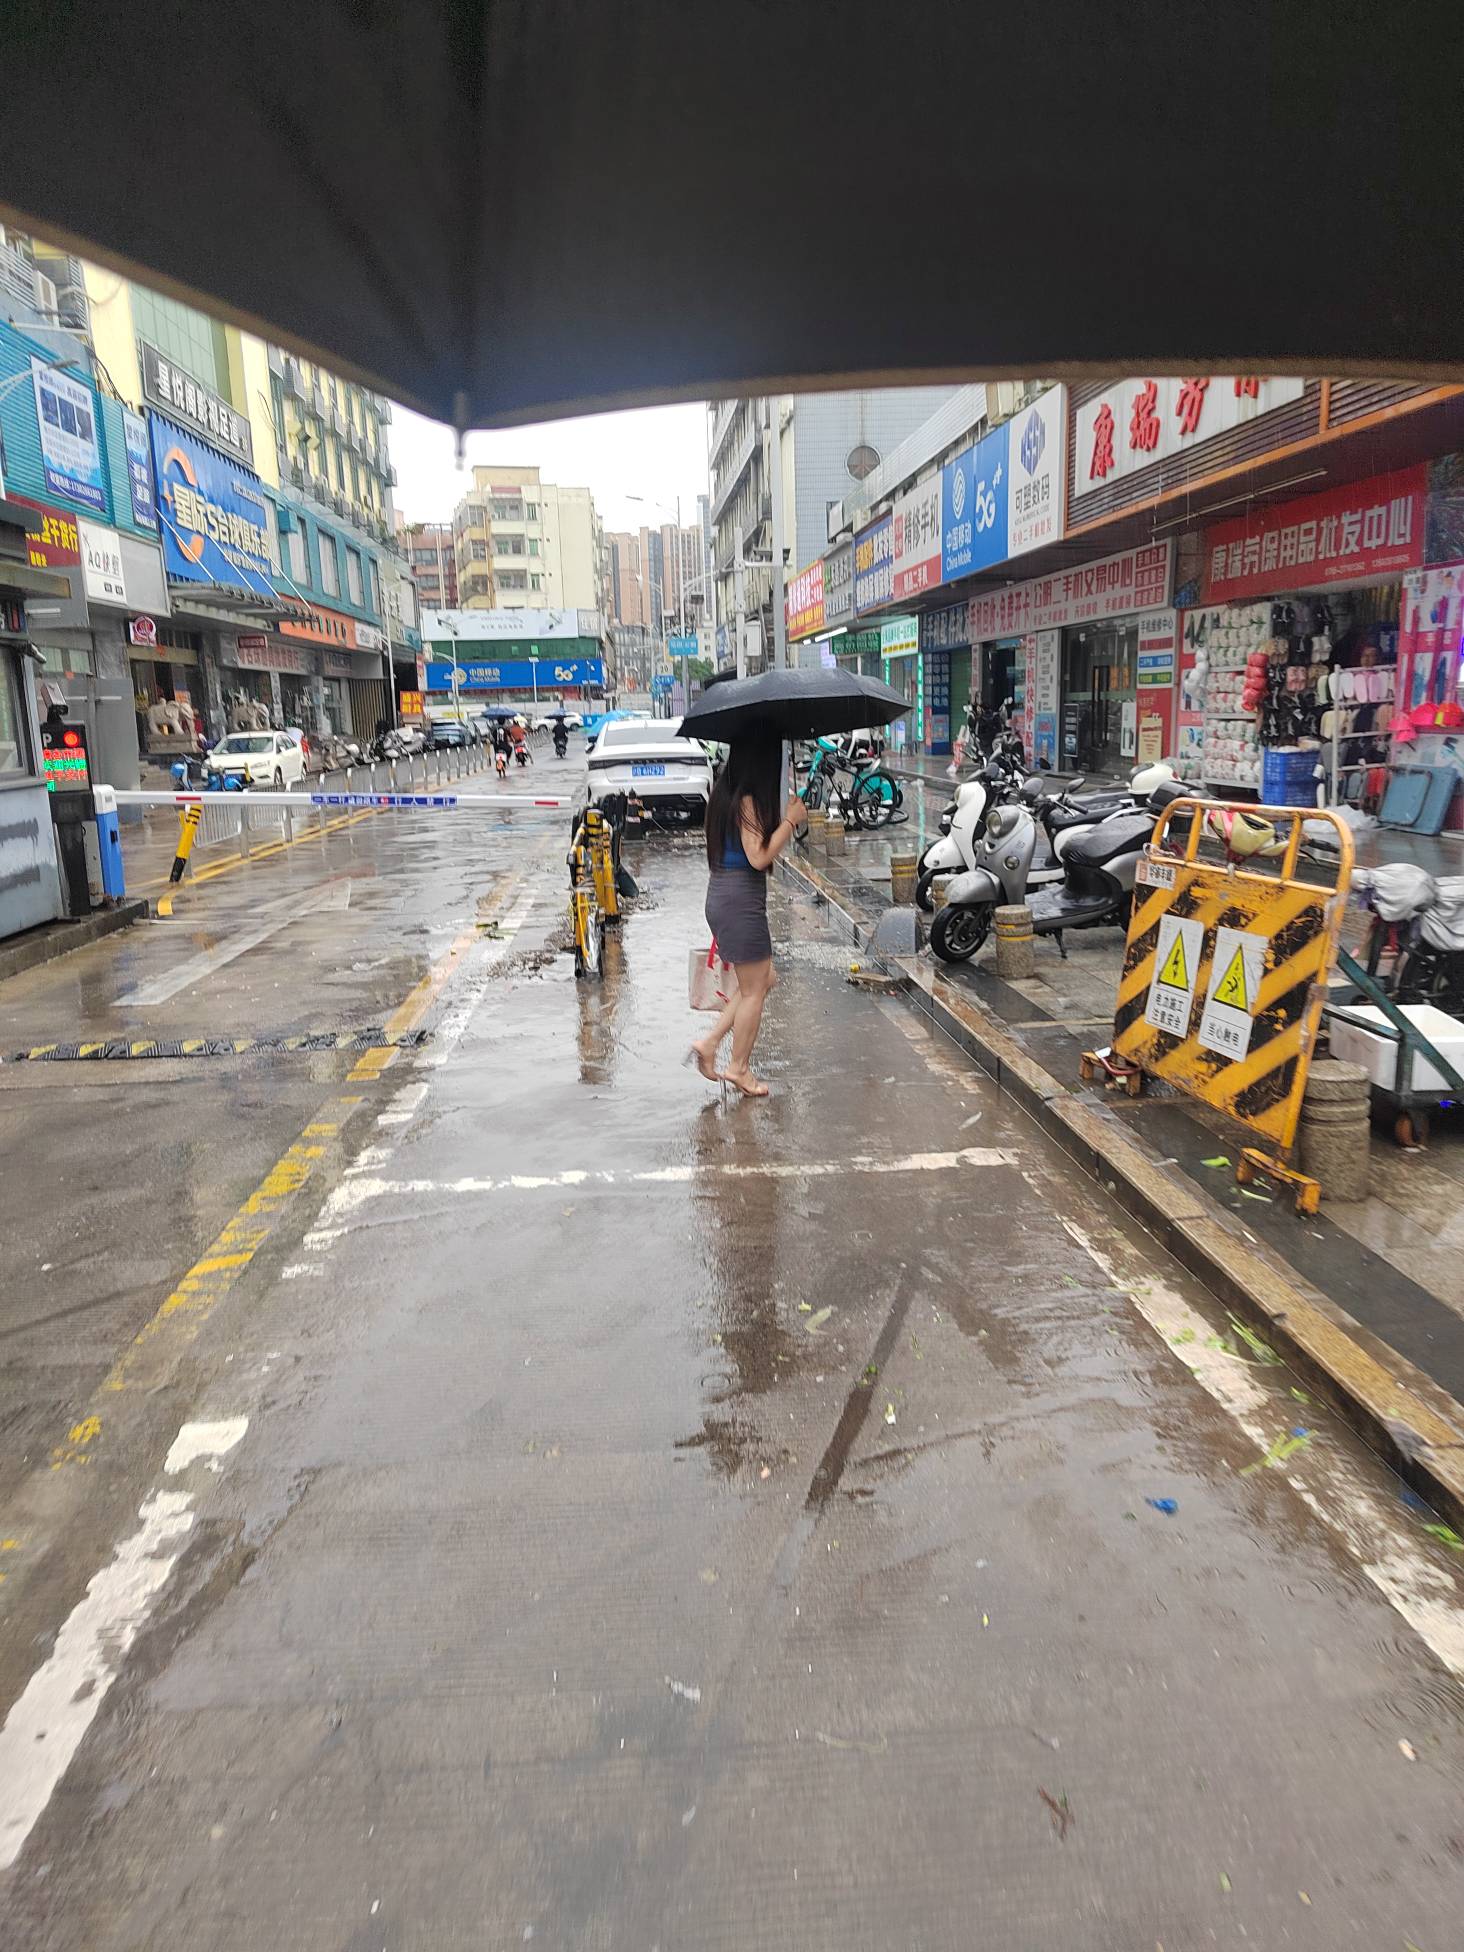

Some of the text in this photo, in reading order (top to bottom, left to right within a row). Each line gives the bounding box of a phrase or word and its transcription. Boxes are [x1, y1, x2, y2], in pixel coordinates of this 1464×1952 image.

[1089, 376, 1269, 481] 康瑞劳
[946, 519, 972, 552] 中国移动
[1211, 495, 1414, 583] 康瑞劳保用品批发中心
[1034, 556, 1133, 609] 公明二手机交易中心
[42, 733, 53, 748] P
